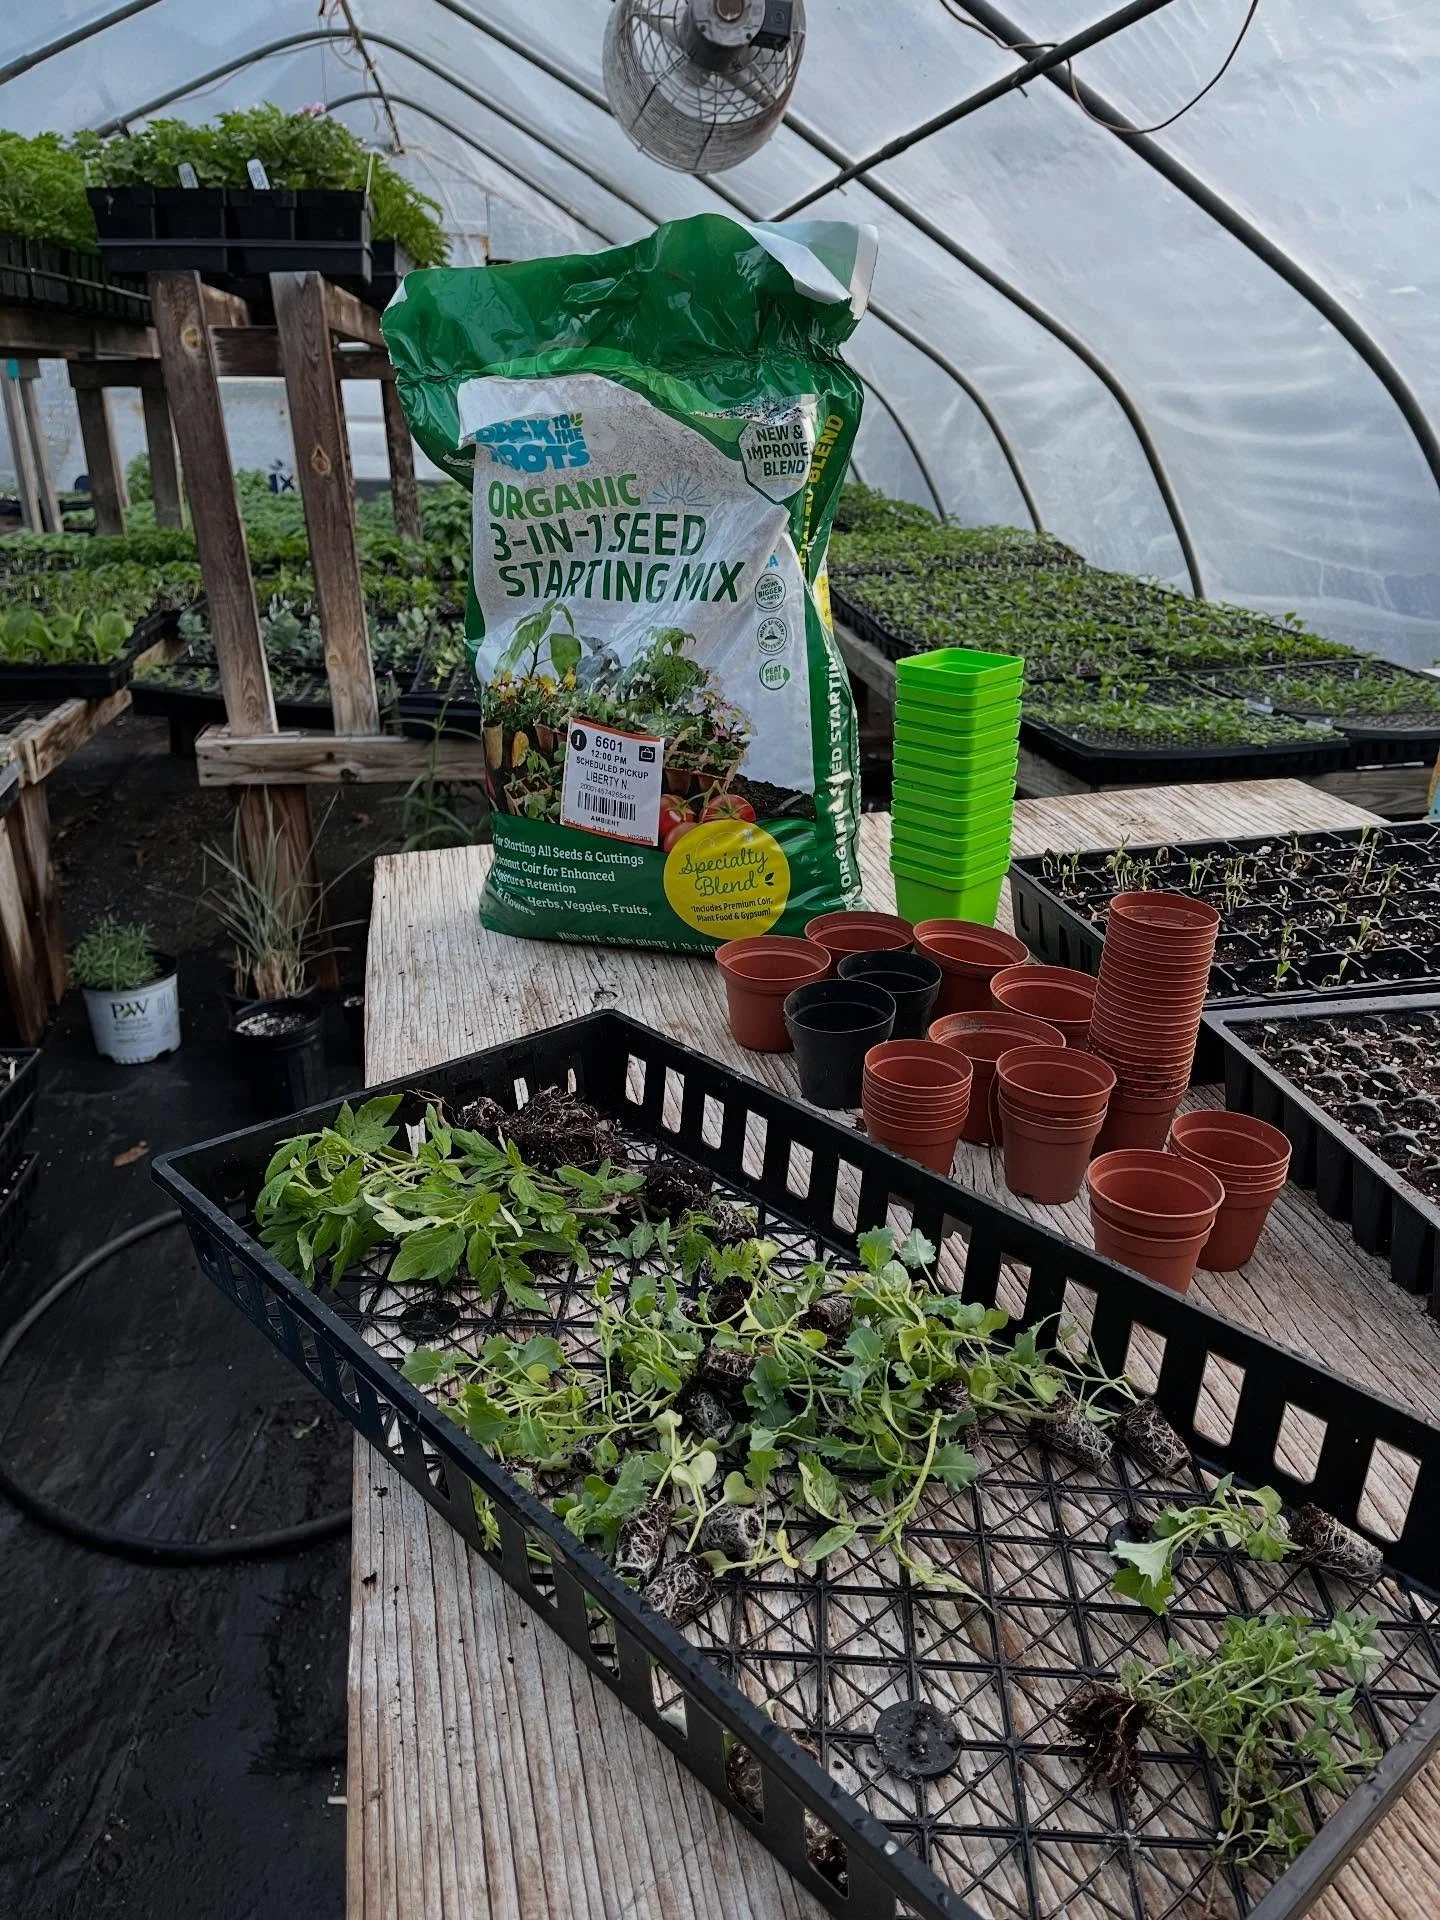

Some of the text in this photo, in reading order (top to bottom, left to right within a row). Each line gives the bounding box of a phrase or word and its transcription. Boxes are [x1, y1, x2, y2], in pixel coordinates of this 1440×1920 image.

[552, 414, 570, 429] TO
[555, 427, 584, 444] THE
[756, 424, 803, 442] NEW &
[808, 414, 844, 484] BLEND
[488, 473, 642, 520] ORGANIC
[608, 512, 707, 556] SEED
[498, 559, 746, 604] STARTING MIX
[758, 586, 783, 599] BIGGER
[765, 664, 782, 676] PEAT
[766, 672, 782, 683] FREE
[595, 736, 623, 753] 6601
[591, 749, 627, 765] 12:00 PM
[576, 756, 649, 780] SCHEDULED PICKUP
[586, 770, 620, 787] LIBERTY
[590, 815, 620, 828] AMBIENT
[504, 837, 536, 857] Starting
[538, 845, 551, 857] All
[553, 847, 583, 861] Seeds
[584, 850, 593, 862] &
[595, 851, 644, 867] Cuttings
[678, 847, 768, 878] Specialty
[522, 861, 541, 875] Coir
[543, 864, 558, 876] for
[561, 867, 616, 882] Enhanced
[495, 868, 526, 887] Moisture
[526, 878, 577, 894] Retention
[695, 871, 759, 897] Blend
[503, 891, 537, 916] Flowers
[565, 900, 612, 914] Veggies,
[613, 903, 652, 917] Fruits,
[723, 898, 756, 911] Premium
[757, 896, 774, 906] Coir,
[696, 908, 771, 923] Plant Food & Gypsum!
